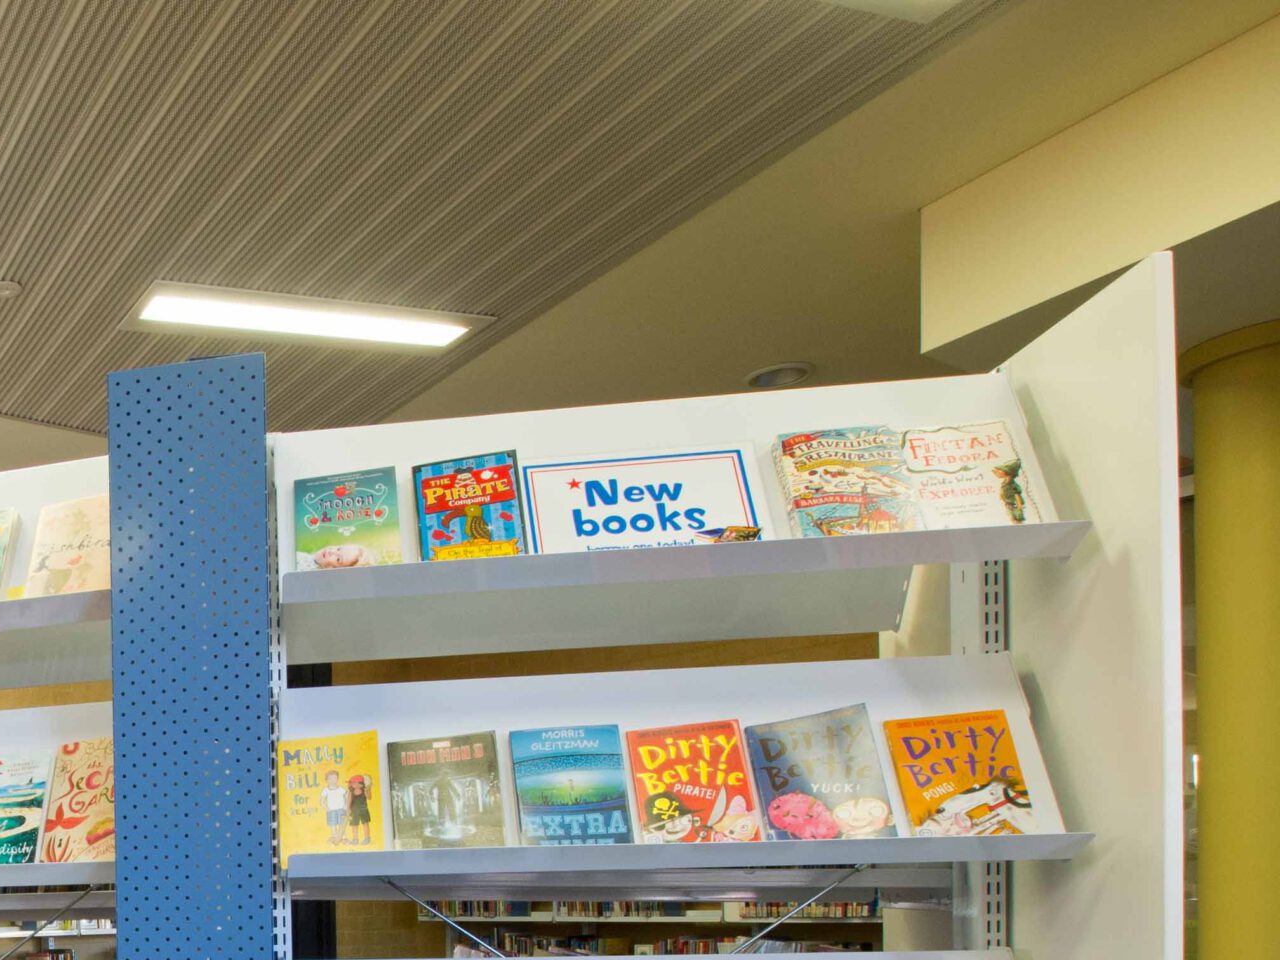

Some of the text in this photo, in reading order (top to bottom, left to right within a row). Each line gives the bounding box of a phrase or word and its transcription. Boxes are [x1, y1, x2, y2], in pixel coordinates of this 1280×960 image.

[796, 436, 884, 453] TRAVELLING
[805, 450, 894, 463] RESTAURANT
[424, 478, 511, 506] PIRATE
[429, 477, 451, 488] THE
[584, 478, 683, 507] New
[572, 502, 707, 537] books
[530, 740, 600, 751] GLEITZMAN
[542, 729, 585, 740] MORRIS
[757, 724, 864, 762] Dirty
[901, 725, 1007, 760] Dirty
[638, 734, 737, 770] Dirty
[636, 759, 744, 796] Bertie
[901, 752, 1016, 788] Bertie
[673, 783, 717, 800] PIRATE!
[810, 783, 860, 793] YUCK!
[922, 781, 956, 801] PONG!
[526, 810, 628, 837] EXTRA
